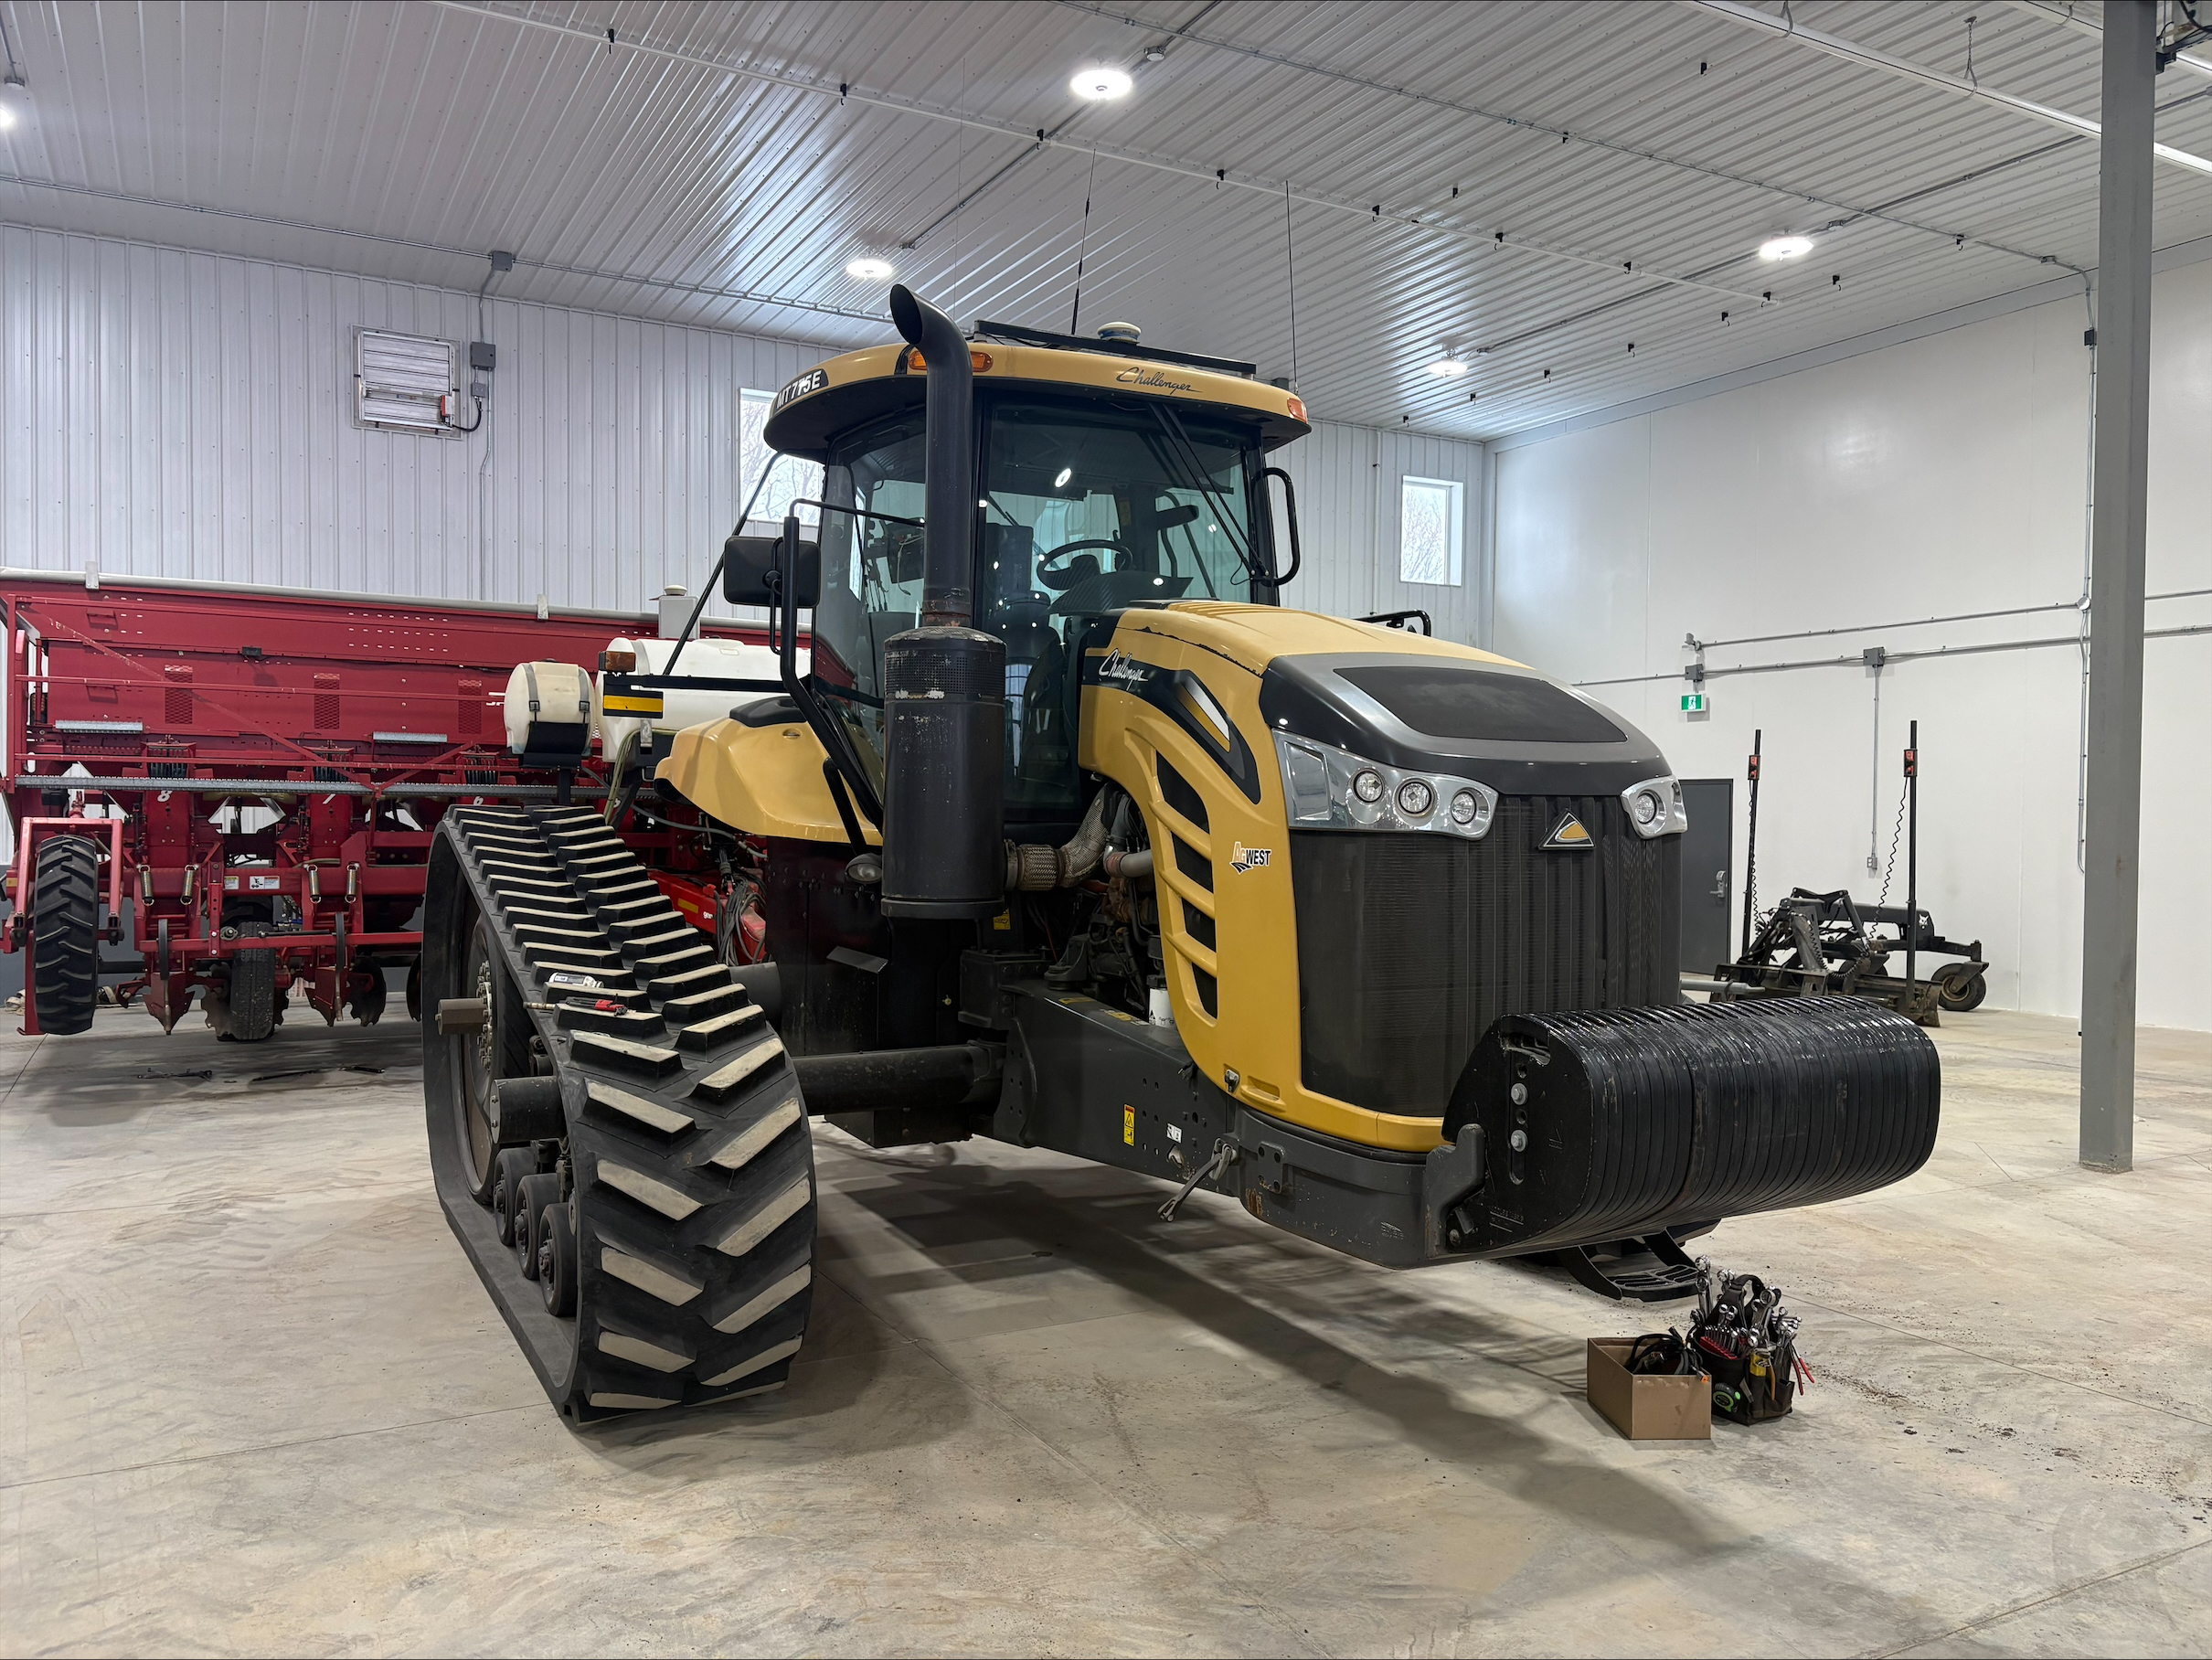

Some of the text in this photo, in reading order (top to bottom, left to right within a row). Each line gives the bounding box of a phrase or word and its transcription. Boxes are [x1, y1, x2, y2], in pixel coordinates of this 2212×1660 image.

[776, 369, 823, 410] MT775E
[1116, 366, 1203, 395] Challenger
[1099, 647, 1149, 691] Challenger
